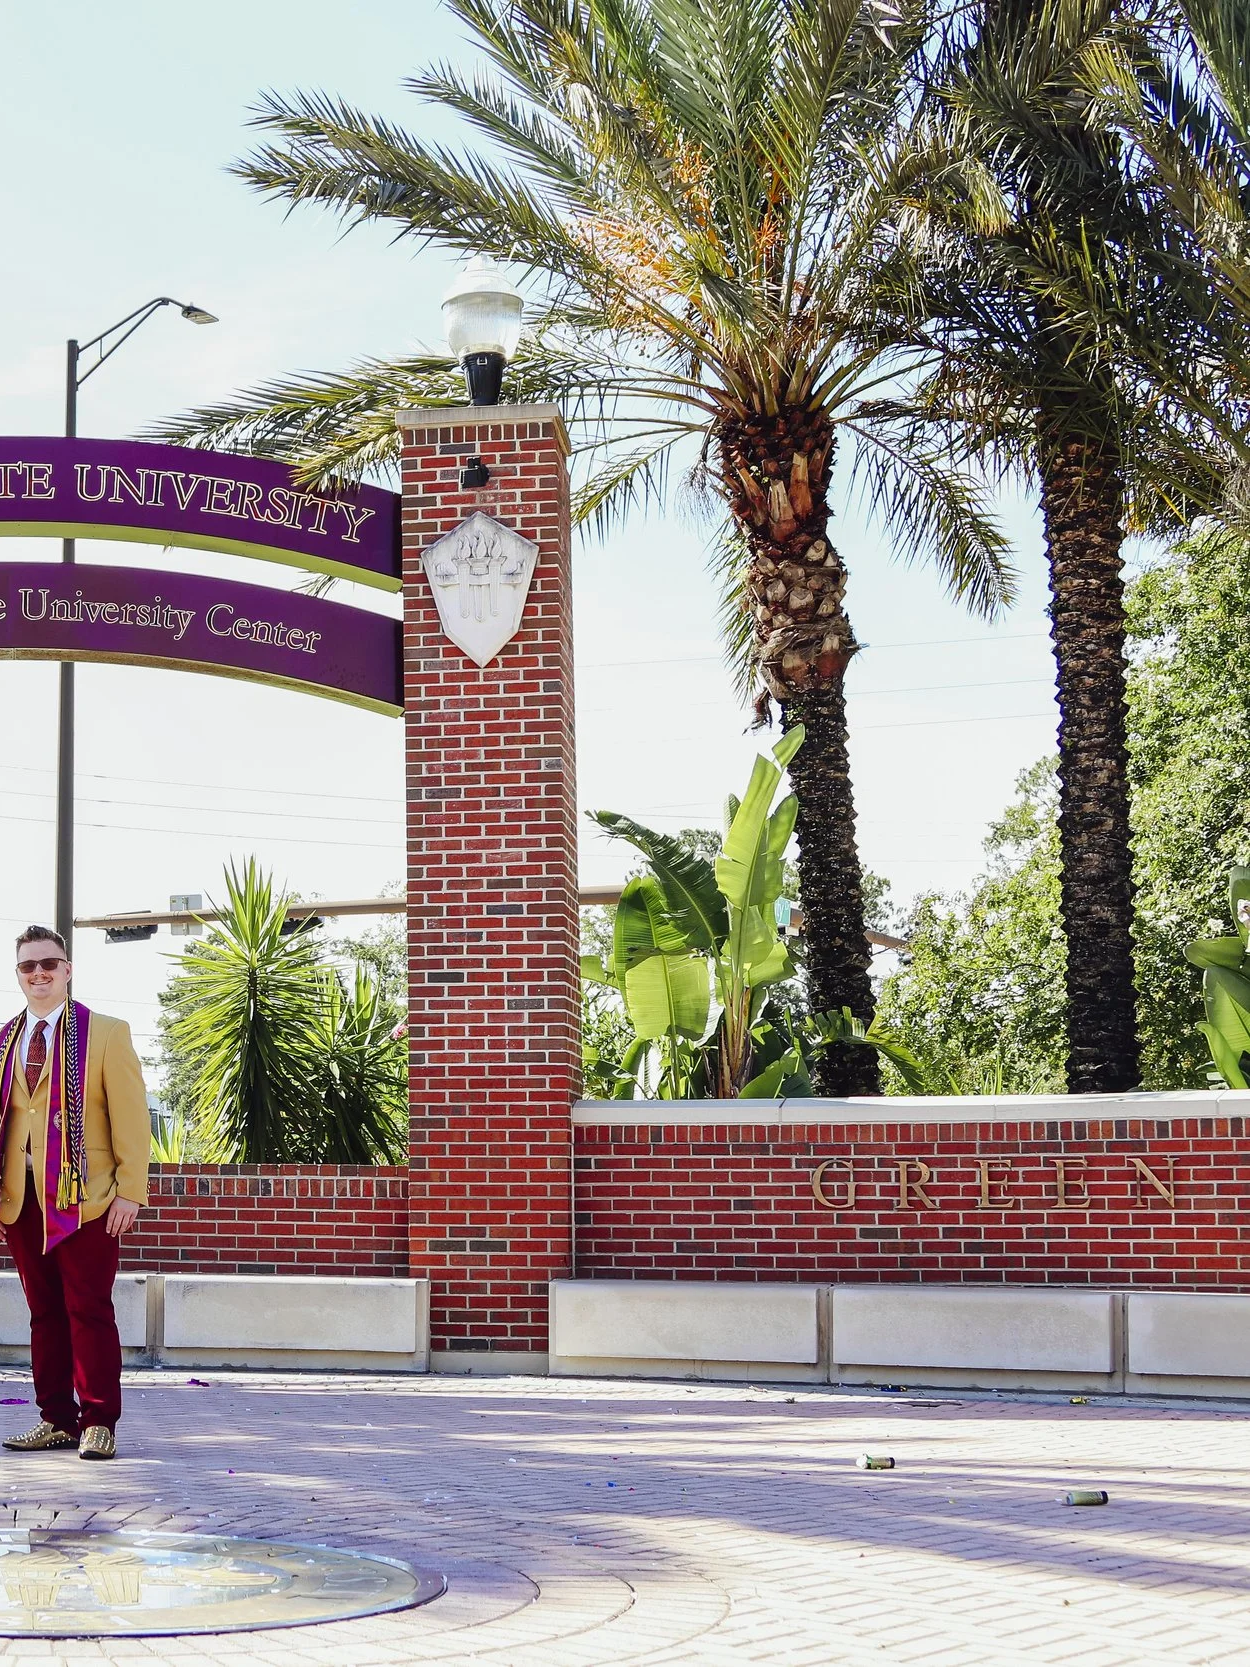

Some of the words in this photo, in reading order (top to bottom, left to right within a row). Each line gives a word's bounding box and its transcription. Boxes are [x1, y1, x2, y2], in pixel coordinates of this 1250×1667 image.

[74, 464, 375, 543] UNIVERSITY
[18, 588, 196, 640] University
[206, 603, 321, 653] Center
[811, 1156, 1180, 1211] GREEN
